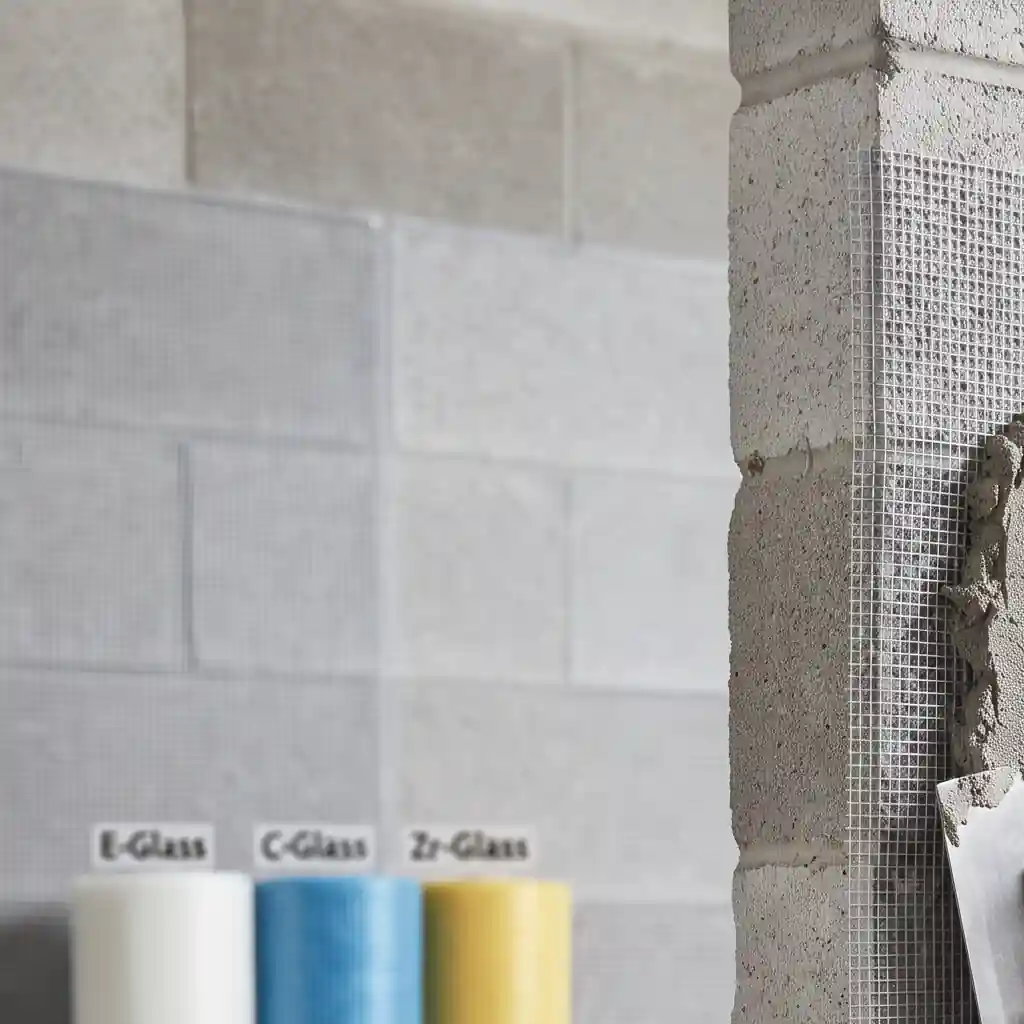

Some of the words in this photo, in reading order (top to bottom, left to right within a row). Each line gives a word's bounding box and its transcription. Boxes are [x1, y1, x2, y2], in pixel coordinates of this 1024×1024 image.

[99, 829, 206, 861] E-Glass
[259, 829, 368, 861] C-Glass
[410, 829, 529, 861] Zr-Glass
